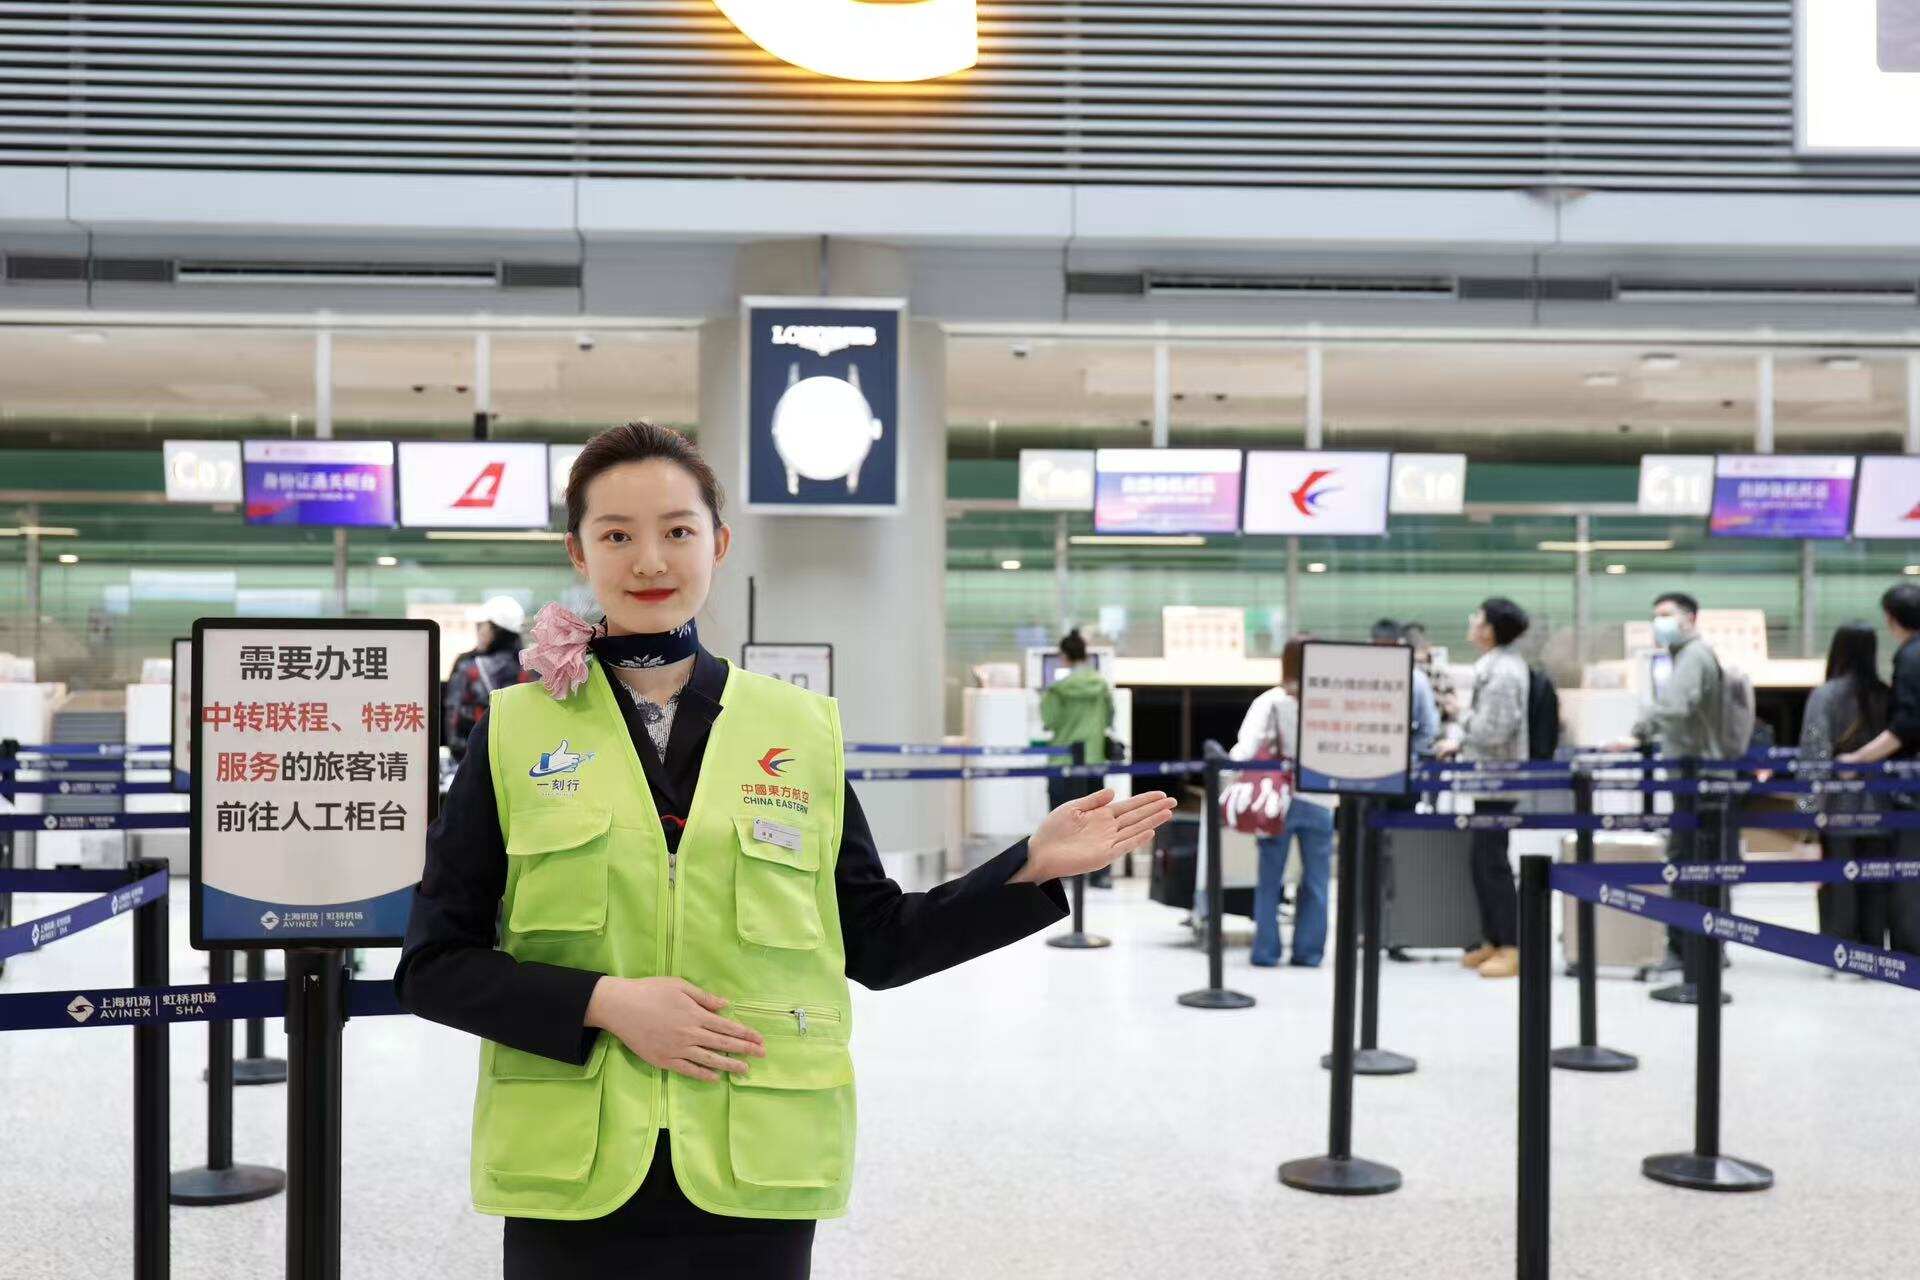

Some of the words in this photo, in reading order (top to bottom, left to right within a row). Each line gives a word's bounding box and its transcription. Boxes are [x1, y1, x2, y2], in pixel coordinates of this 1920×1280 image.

[240, 645, 388, 680] 需要办理
[216, 751, 408, 782] 服务的旅客请
[537, 779, 580, 791] 一刻行
[741, 784, 810, 804] 中國東方航空
[743, 796, 773, 806] CHINA
[776, 799, 808, 814] EASTERN
[216, 800, 408, 832] 前往人工柜台
[100, 995, 151, 1009] 上海机场
[162, 992, 216, 1006] 虹桥机场
[100, 1008, 151, 1019] AVINEX
[176, 1005, 205, 1015] SHA
